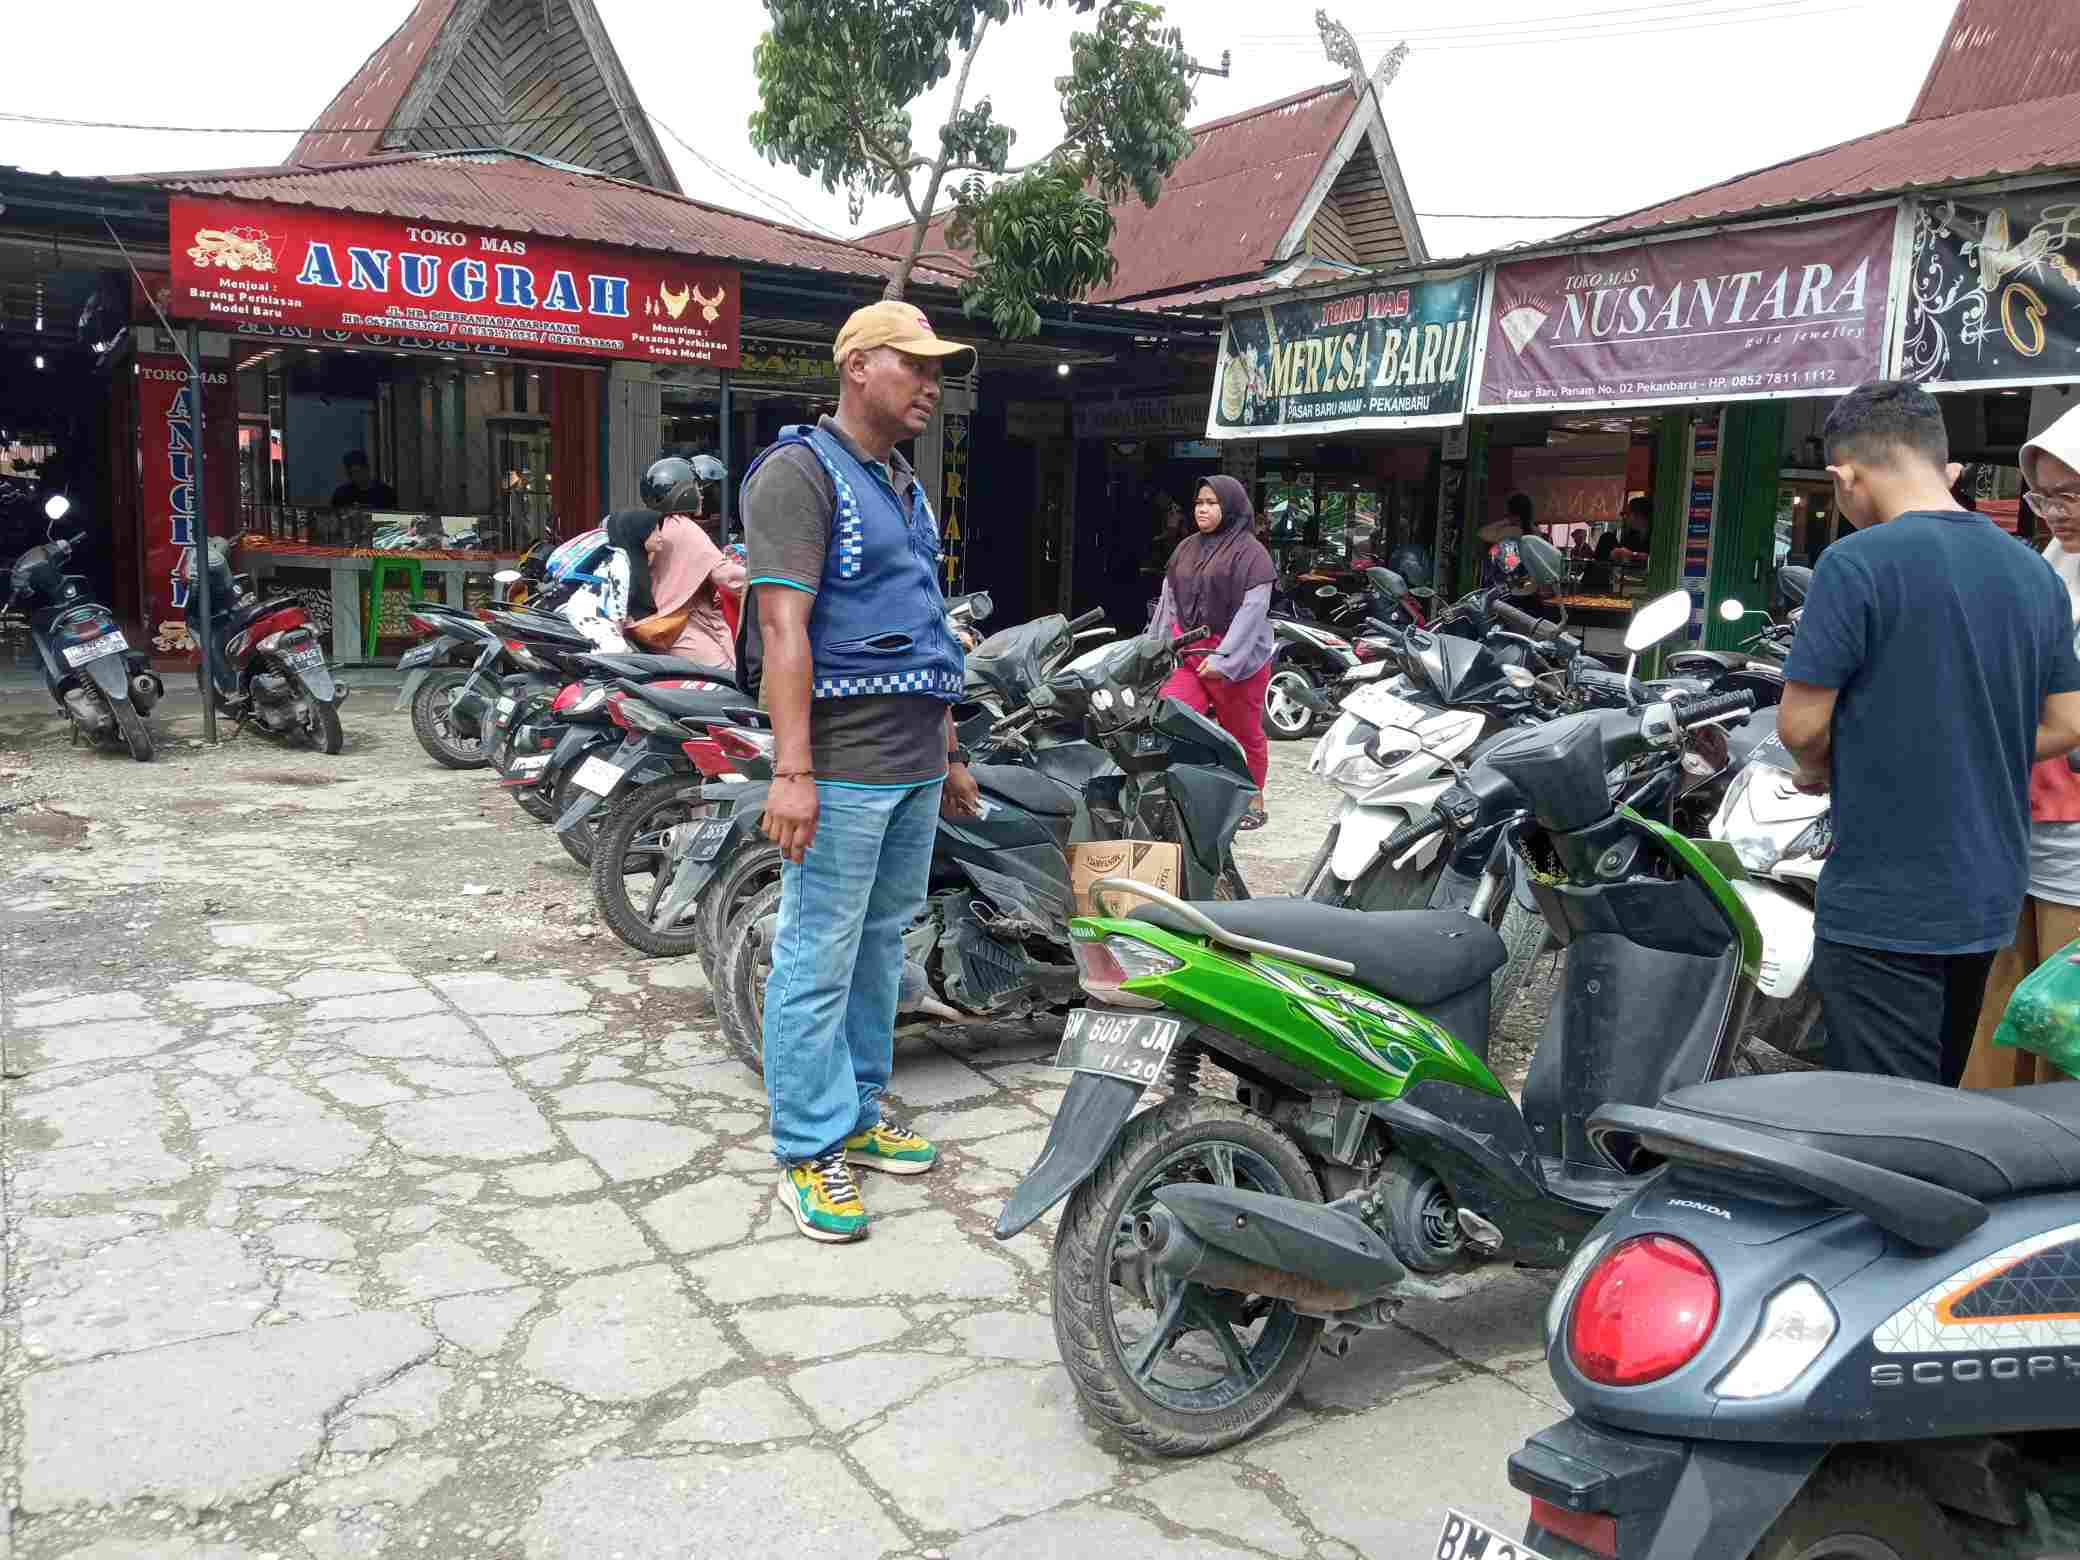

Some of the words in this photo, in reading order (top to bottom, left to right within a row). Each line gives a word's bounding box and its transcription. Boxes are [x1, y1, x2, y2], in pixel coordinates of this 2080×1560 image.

[407, 227, 466, 246] TOKO
[480, 237, 526, 255] MAS
[219, 277, 269, 291] Menjual
[295, 240, 630, 318] ANUGRAH
[1565, 274, 1600, 290] TOKO
[190, 287, 234, 302] Barang
[240, 292, 302, 308] Perhiasan
[1552, 256, 1870, 340] NUSANTARA
[210, 302, 249, 314] Model
[253, 306, 282, 318] Baru
[680, 348, 711, 361] Model
[1265, 332, 1369, 398] MERYSA
[1373, 321, 1467, 387] BARU
[142, 368, 188, 382] TOKO
[1506, 388, 1533, 399] Pasar
[1561, 386, 1595, 396] Panam
[1598, 384, 1615, 395] No.
[1619, 383, 1634, 393] 02
[1637, 380, 1697, 393] Pekanbaru
[1732, 375, 1762, 386] 0852
[1766, 371, 1798, 384] 7811
[1804, 368, 1836, 382] 1112
[1288, 403, 1313, 418] PASAR
[1315, 402, 1337, 417] BARU
[1369, 396, 1430, 412] PEKANBARU
[1089, 1015, 1139, 1044] 6067
[1141, 1021, 1172, 1051] JA
[1667, 1199, 1731, 1219] HONDA
